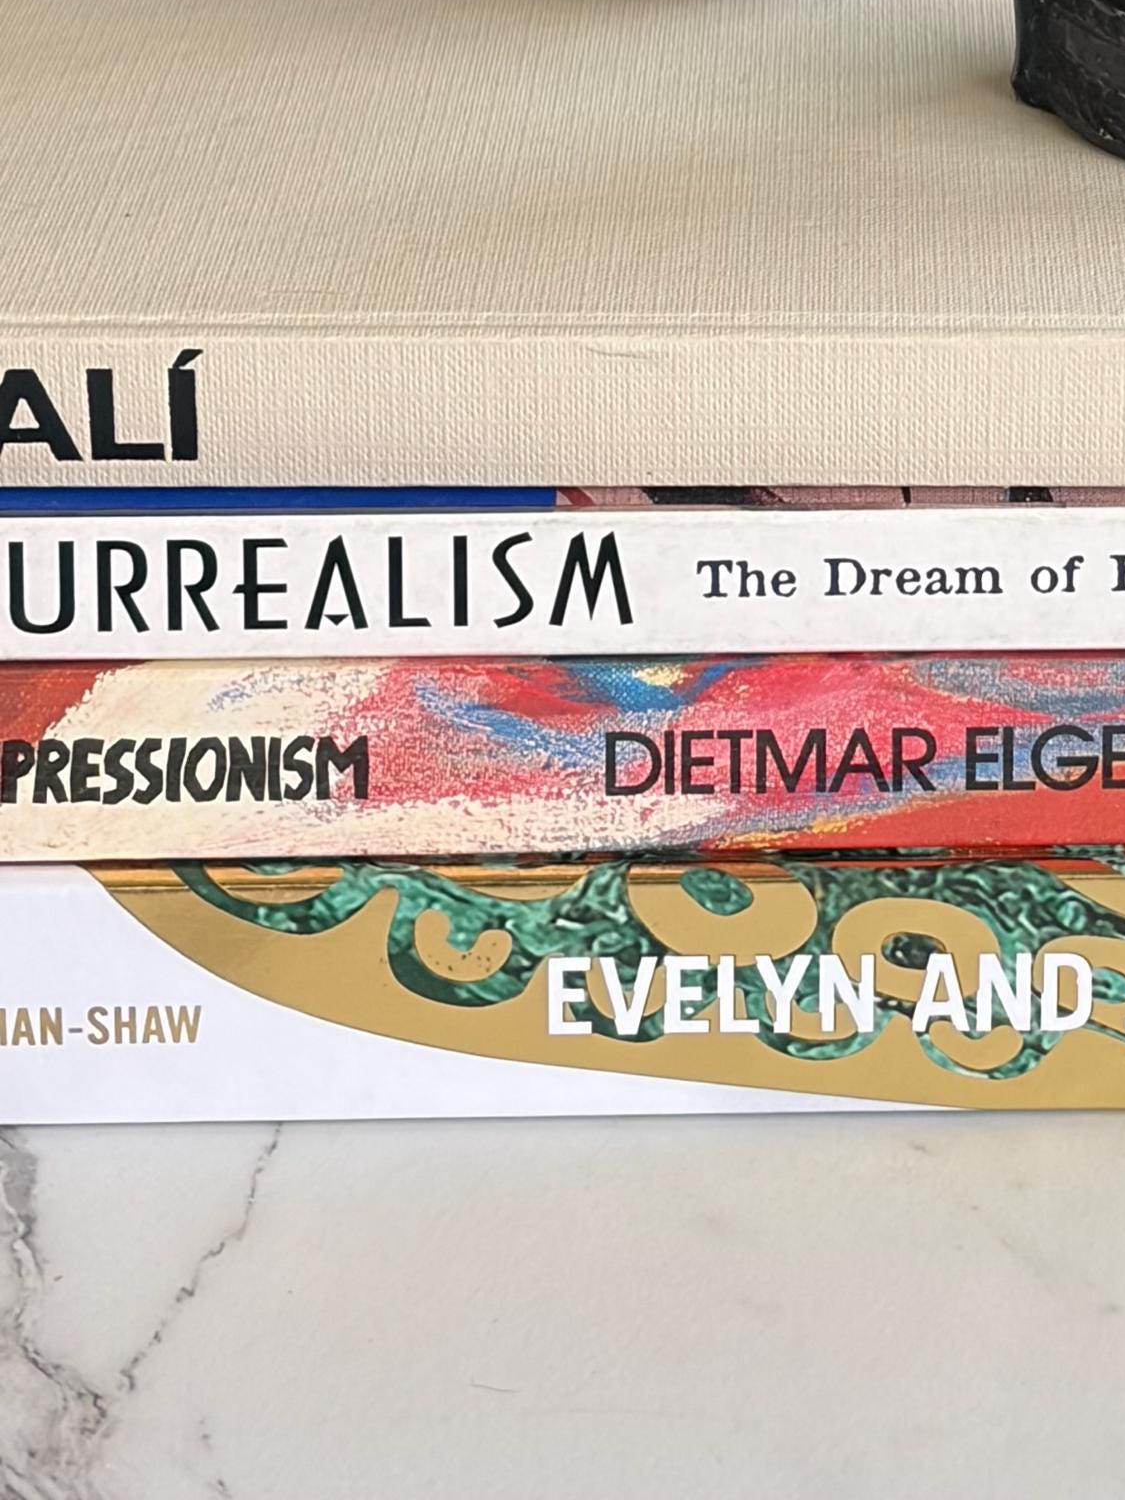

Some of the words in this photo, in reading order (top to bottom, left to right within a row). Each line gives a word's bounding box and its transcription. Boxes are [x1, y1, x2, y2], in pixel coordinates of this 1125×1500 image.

[0, 348, 204, 461] ALÍ
[8, 531, 634, 635] URREALISM
[696, 558, 798, 599] The
[824, 556, 1004, 596] Dream
[1029, 555, 1086, 594] of
[1, 734, 369, 805] PRESSIONISM
[606, 726, 938, 796] DIETMAR
[547, 953, 877, 1037] EVELYN
[911, 952, 1094, 1034] AND
